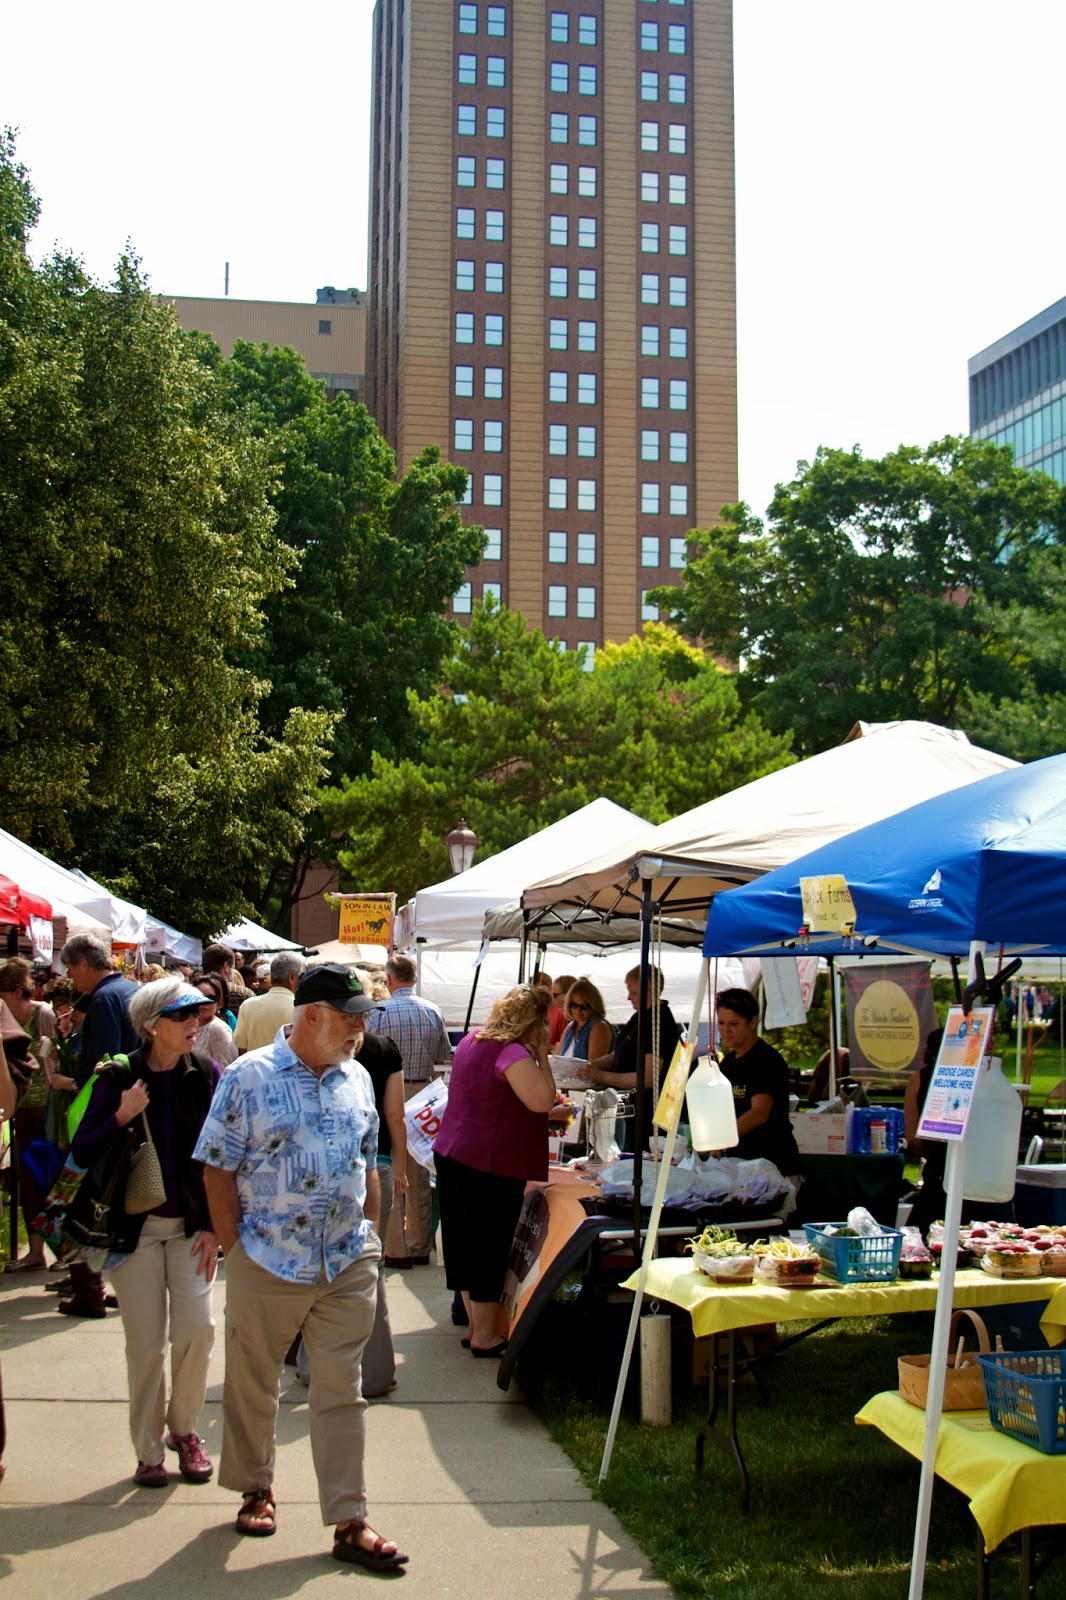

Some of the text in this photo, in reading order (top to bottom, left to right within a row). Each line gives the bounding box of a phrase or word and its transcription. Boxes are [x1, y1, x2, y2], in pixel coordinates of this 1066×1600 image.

[344, 902, 391, 911] SON-IN-LAW
[343, 921, 365, 934] Hot!
[937, 1067, 975, 1077] BRIDGE CARDS
[933, 1079, 974, 1089] WELCOME HERE
